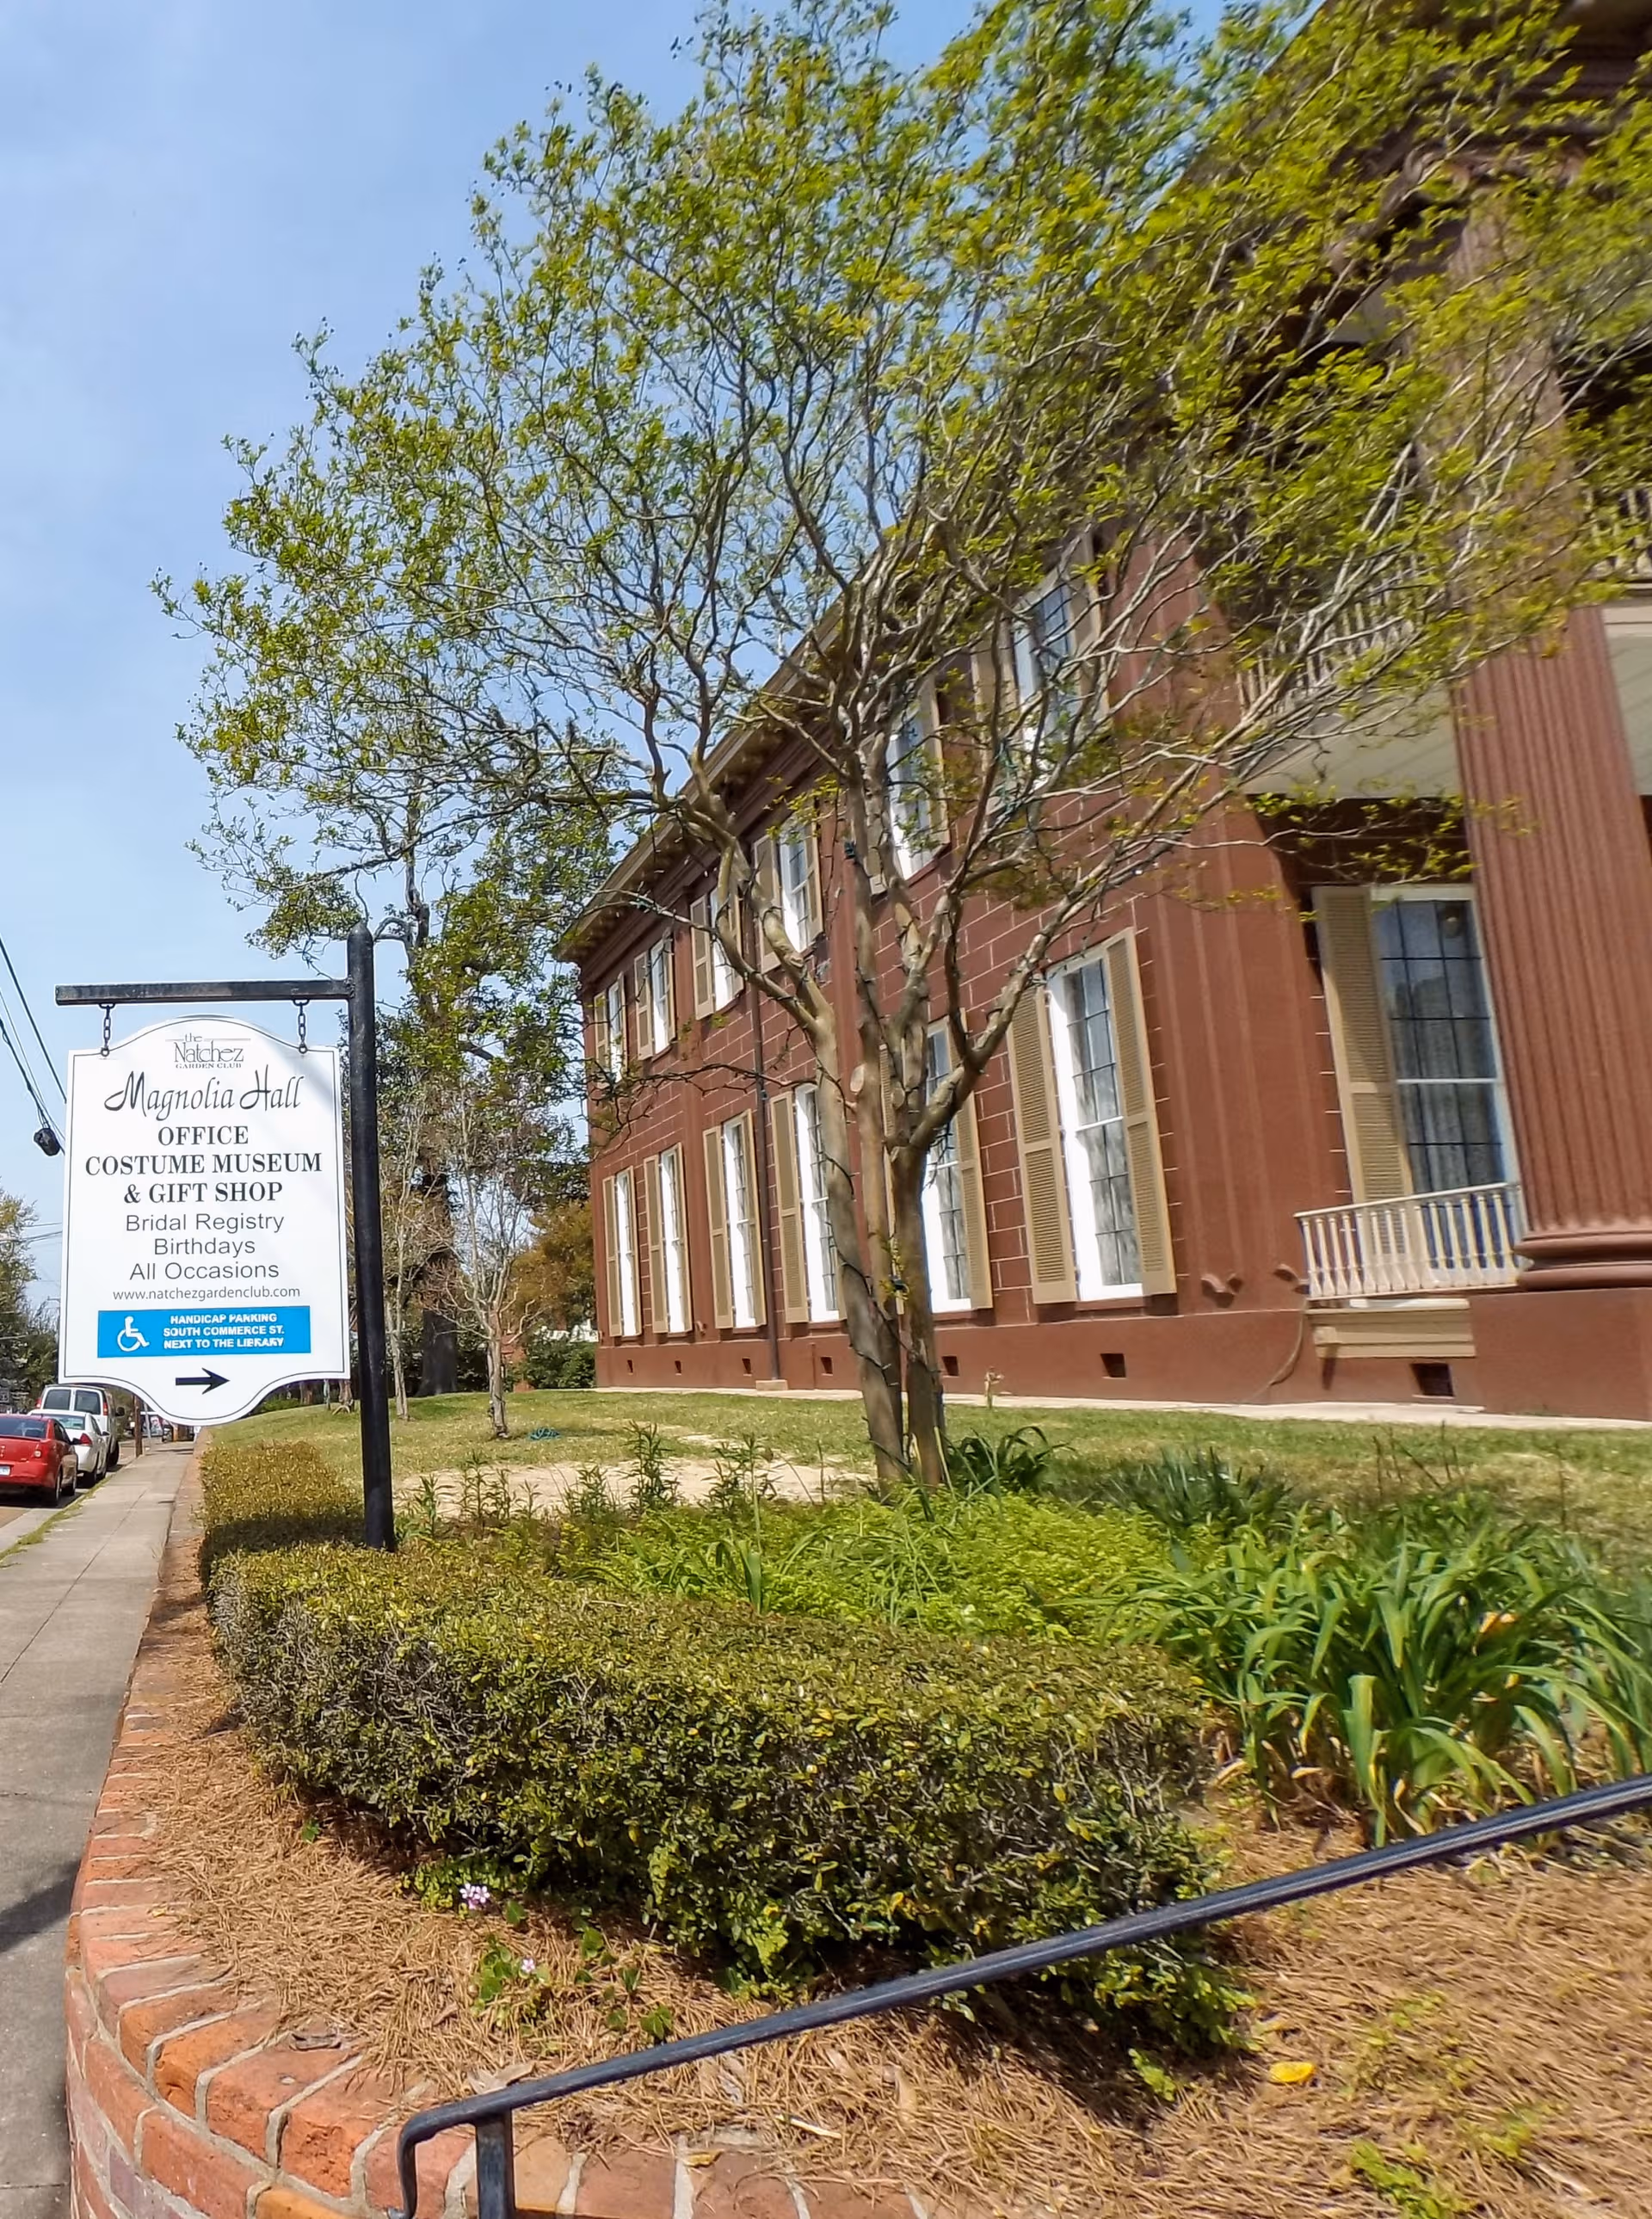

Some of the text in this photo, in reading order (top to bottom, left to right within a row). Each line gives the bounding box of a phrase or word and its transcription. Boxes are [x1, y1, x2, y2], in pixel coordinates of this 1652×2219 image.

[184, 1032, 202, 1042] the
[174, 1041, 243, 1063] Natchez
[104, 1064, 304, 1121] Magnolia Hall
[158, 1125, 249, 1146] OFFICE
[86, 1152, 322, 1175] COSTUME MUSEUM
[124, 1181, 282, 1203] & GIFT SHOP
[126, 1213, 284, 1233] Bridal Registry
[155, 1238, 255, 1258] Birthdays
[130, 1261, 279, 1280] All Occasions
[114, 1286, 300, 1302] www.natchezgardenclub.com
[170, 1313, 277, 1324] HANDICAP PARKING
[163, 1325, 285, 1337] SOUTH COMMERCE ST.
[163, 1337, 284, 1349] NEXT TO THE LIBRARY
